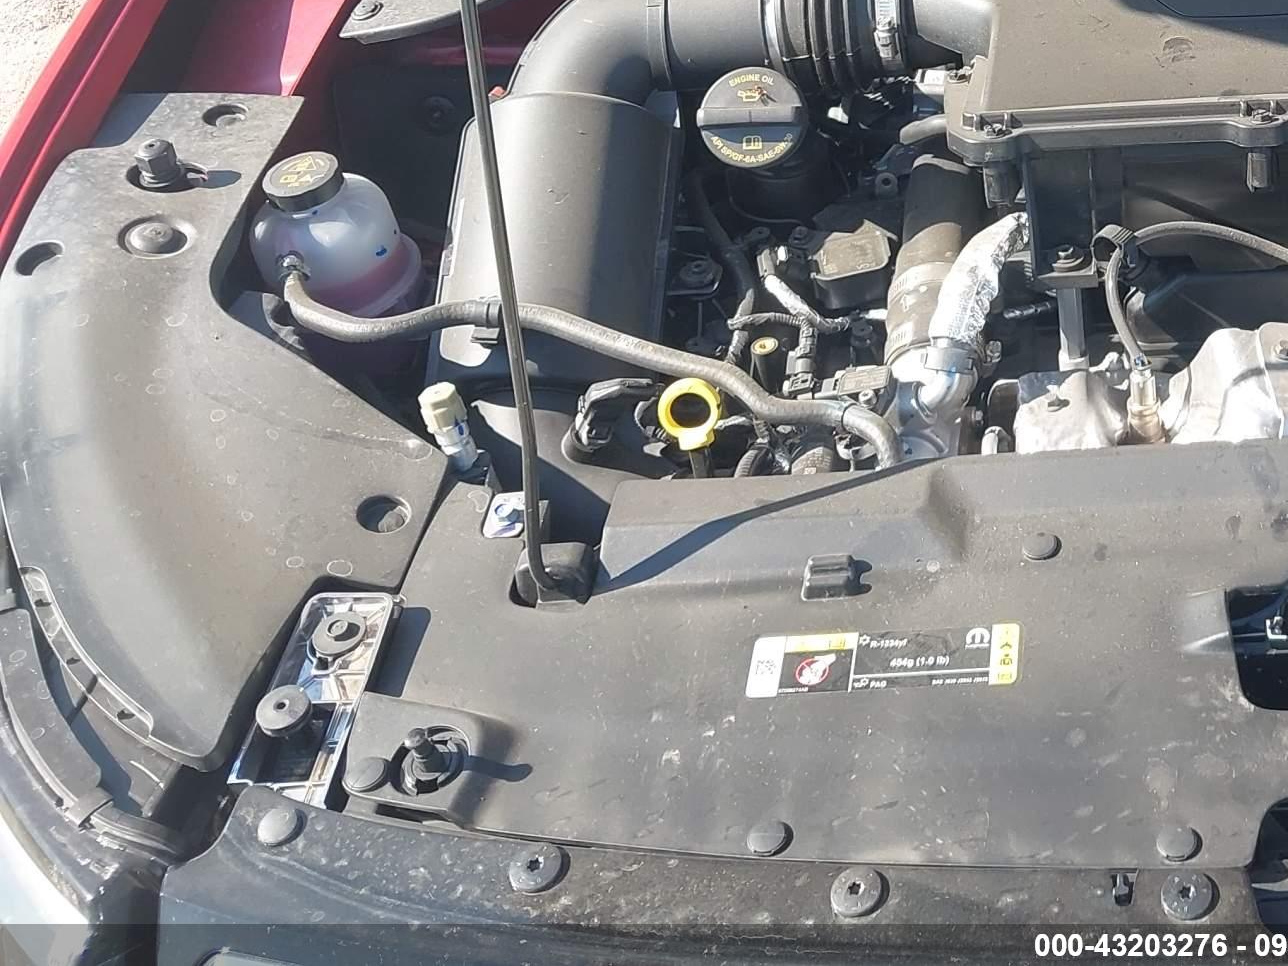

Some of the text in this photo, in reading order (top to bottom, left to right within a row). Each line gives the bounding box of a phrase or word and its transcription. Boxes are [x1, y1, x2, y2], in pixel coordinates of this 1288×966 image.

[729, 73, 775, 87] ENGINE OIL
[711, 136, 721, 149] API
[889, 655, 950, 668] 454g (1.0 lb)
